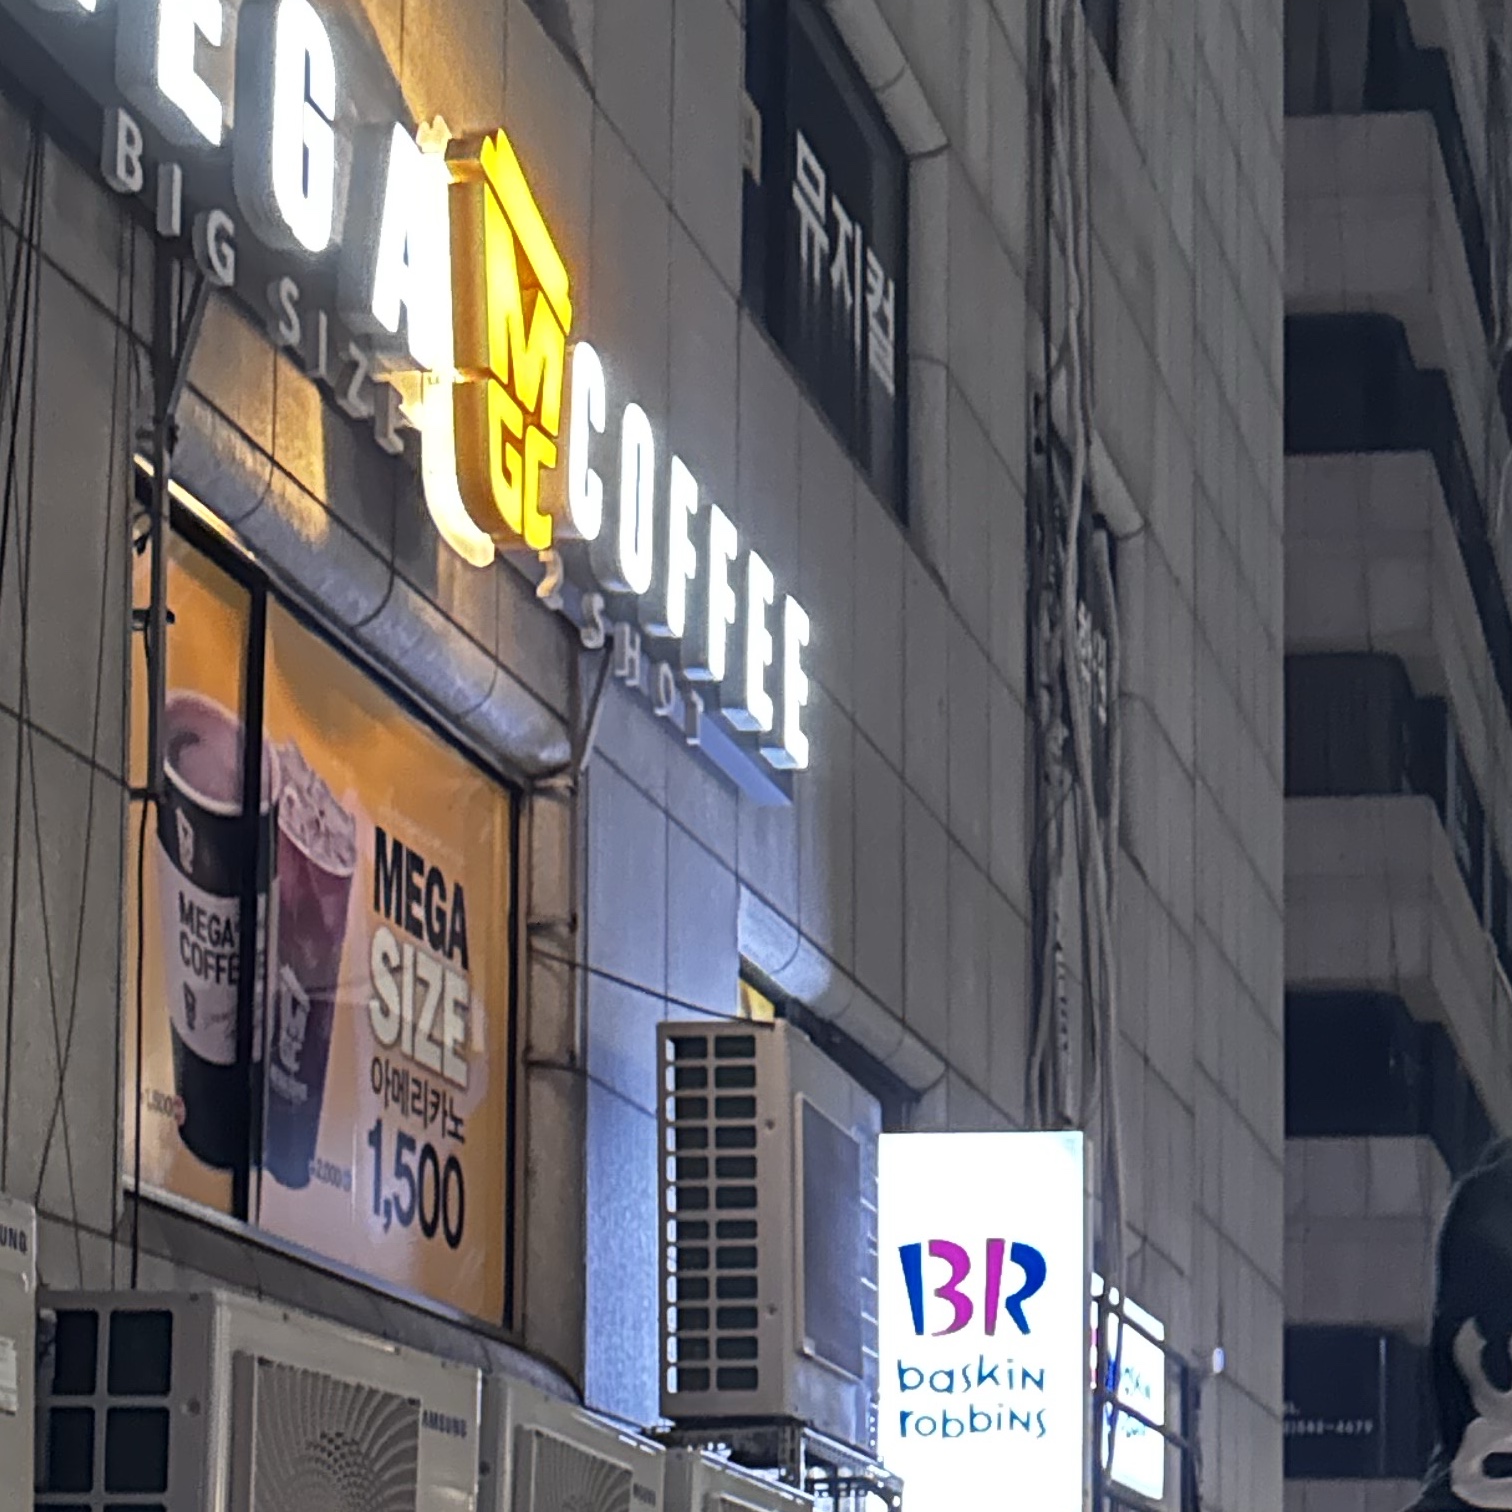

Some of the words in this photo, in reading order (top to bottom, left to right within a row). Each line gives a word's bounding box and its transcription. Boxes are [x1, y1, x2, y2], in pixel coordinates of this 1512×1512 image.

[73, 0, 452, 370] EGA
[103, 107, 235, 286] BIG
[792, 128, 895, 397] 뮤지컬
[567, 341, 810, 769] COFFEE
[580, 592, 704, 746] SHOT
[178, 889, 236, 949] MEGA
[373, 826, 469, 971] MEGA
[368, 925, 470, 1091] SIZE
[371, 1055, 466, 1145] 아메리카노
[0, 1223, 27, 1256] UNG
[367, 1117, 466, 1251] 1,500
[898, 1238, 1047, 1336] BR
[422, 1409, 467, 1438] AMSUNG
[897, 1355, 1046, 1394] baskin
[899, 1403, 1047, 1439] robbins
